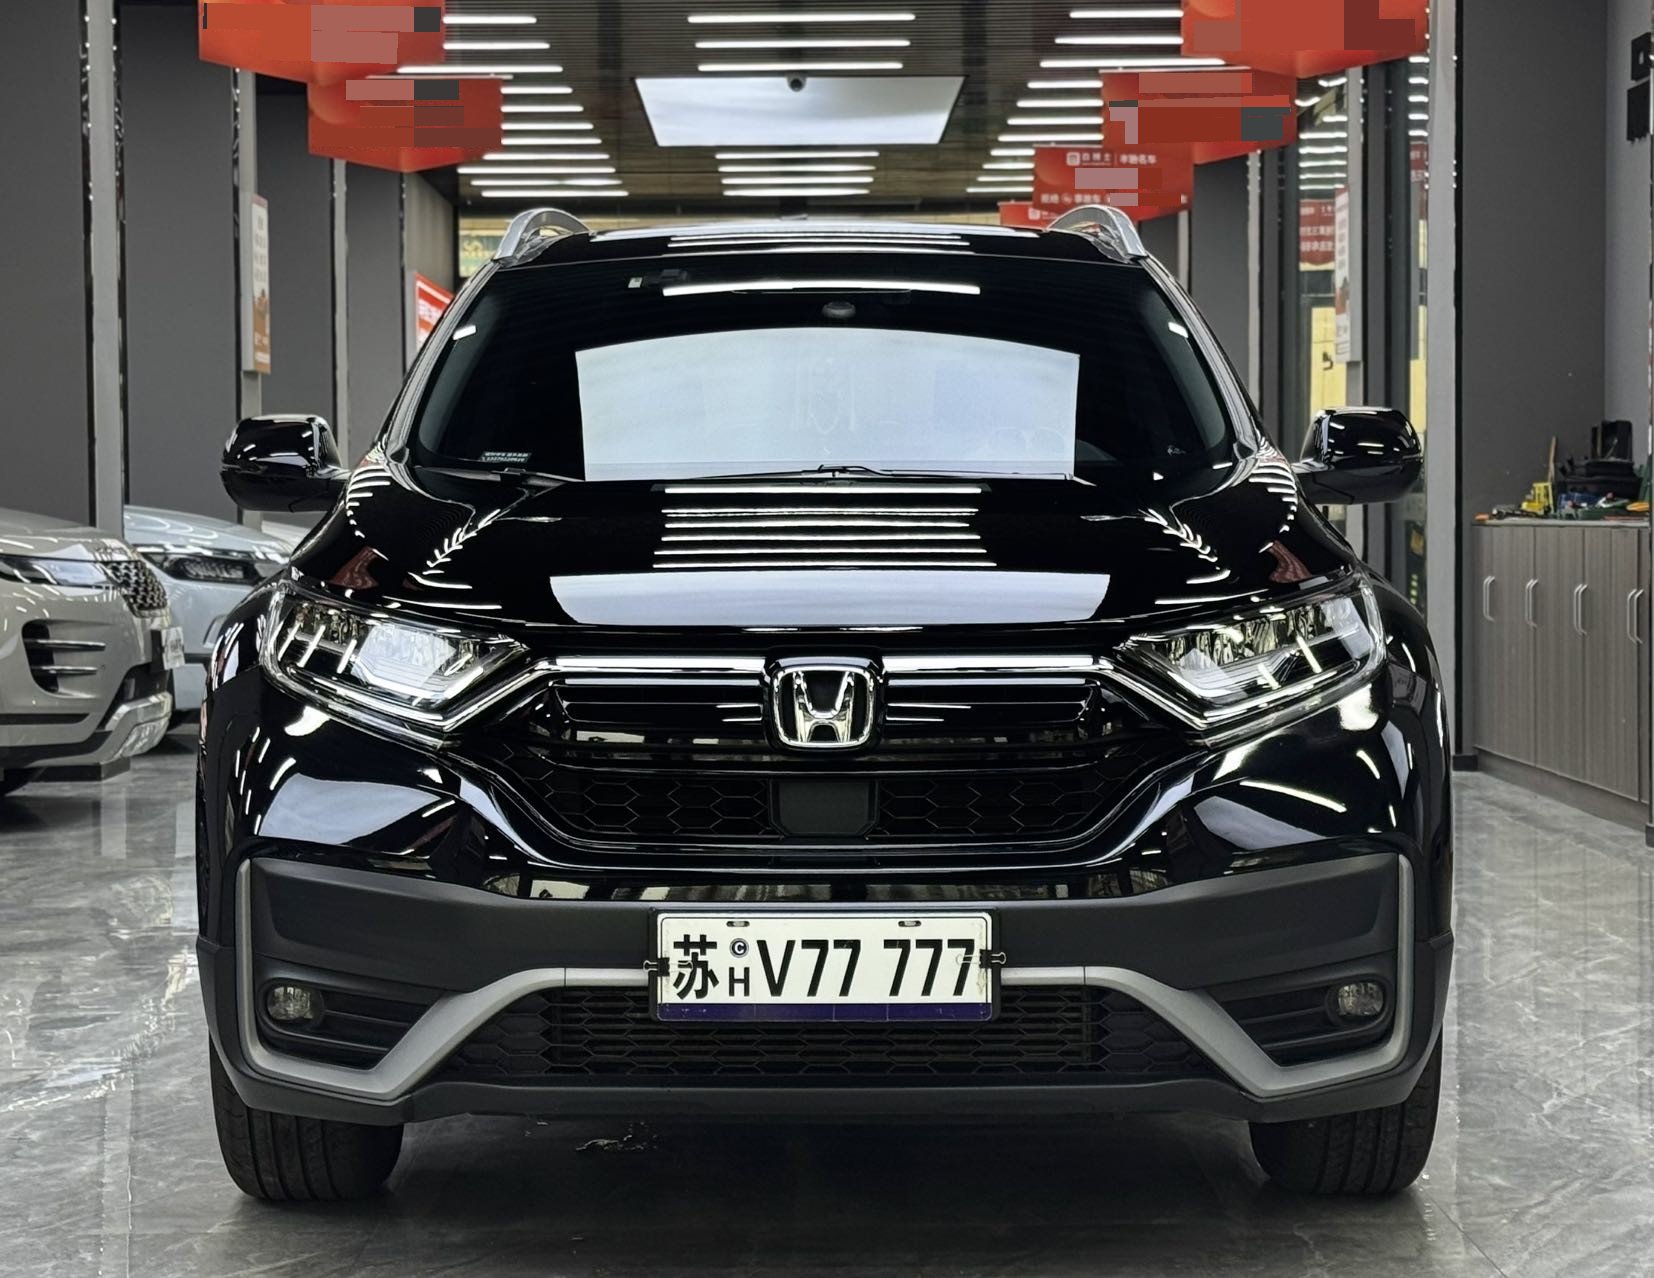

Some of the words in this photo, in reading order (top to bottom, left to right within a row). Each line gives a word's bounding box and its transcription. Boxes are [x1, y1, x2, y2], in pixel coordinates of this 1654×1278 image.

[673, 934, 719, 1000] 苏
[756, 939, 861, 997] V77
[883, 939, 975, 997] 777
